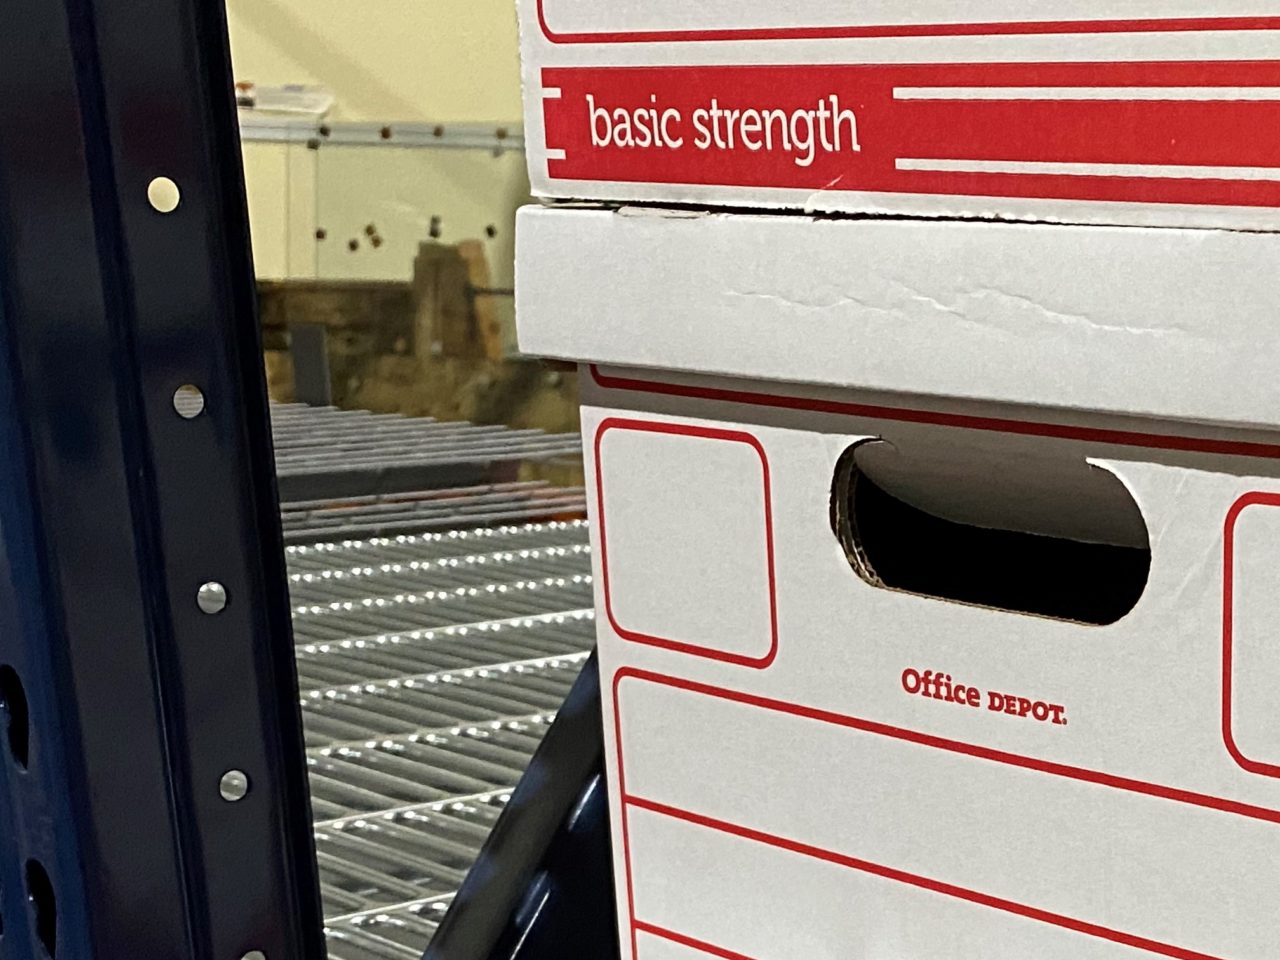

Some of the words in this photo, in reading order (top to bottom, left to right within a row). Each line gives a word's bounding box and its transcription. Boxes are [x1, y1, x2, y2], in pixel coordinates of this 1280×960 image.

[586, 94, 684, 149] basic
[693, 95, 861, 167] strength
[901, 668, 981, 708] Office
